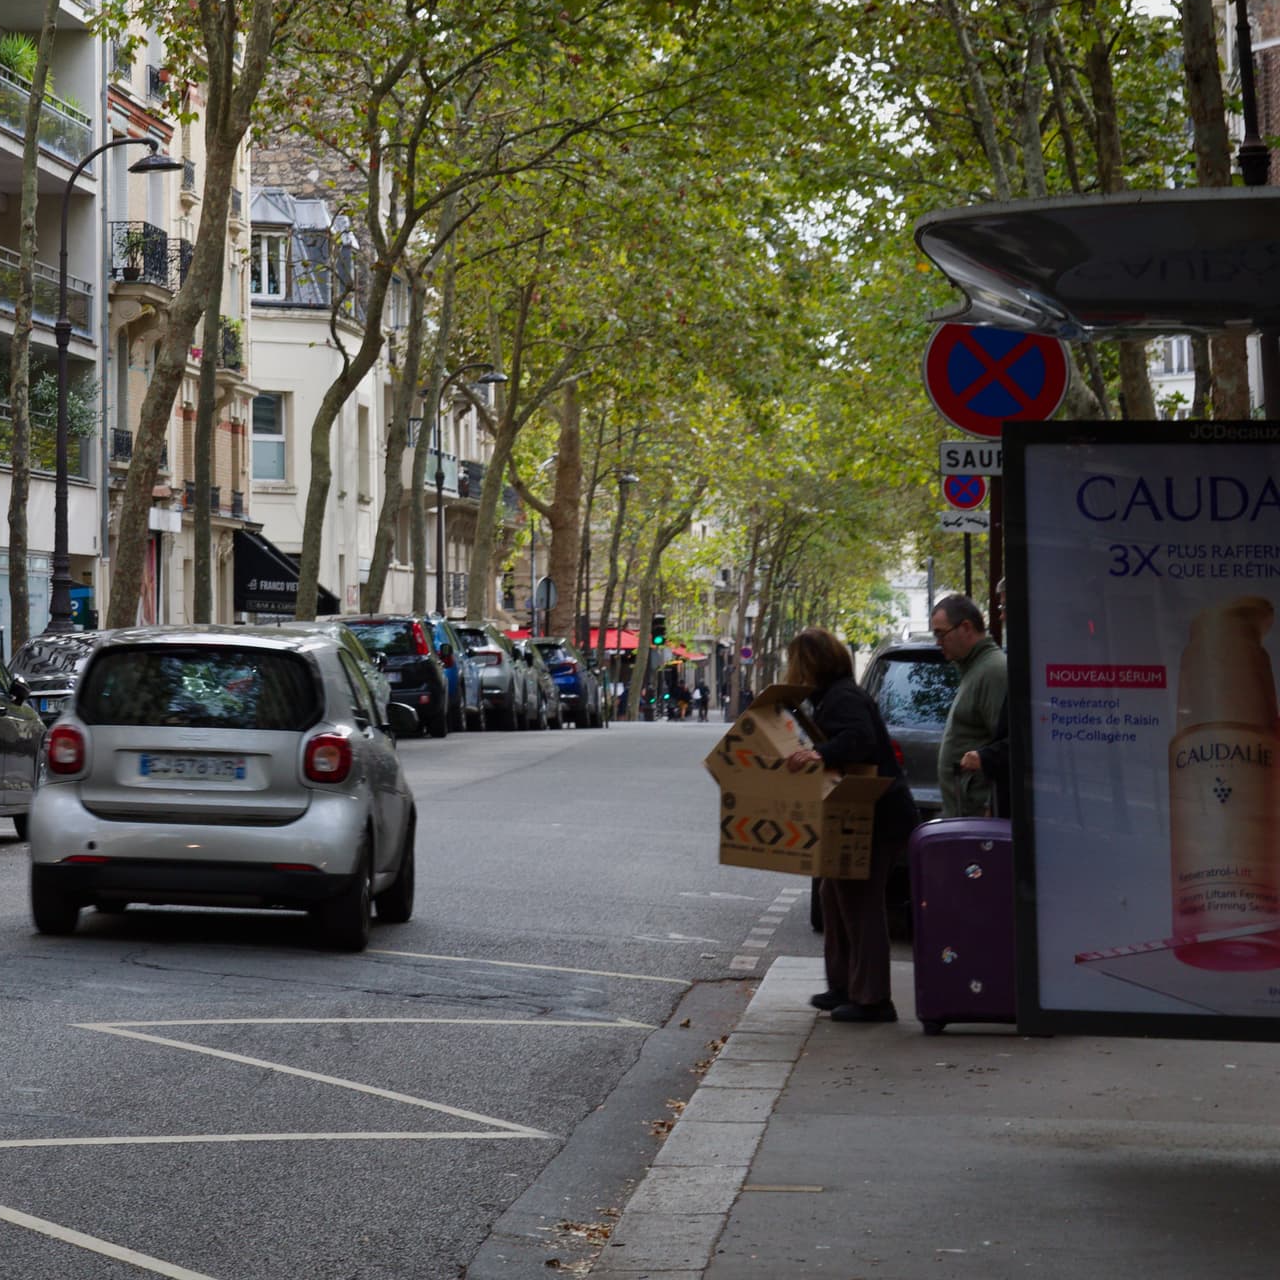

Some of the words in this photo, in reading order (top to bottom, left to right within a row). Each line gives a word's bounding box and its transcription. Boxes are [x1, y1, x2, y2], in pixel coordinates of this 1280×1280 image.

[1189, 424, 1280, 441] JCDecaux
[1109, 544, 1164, 577] 3X
[1167, 544, 1207, 560] PLUS
[1167, 563, 1208, 580] QUE
[1210, 563, 1229, 578] LE
[259, 580, 286, 592] FRANCO
[1049, 670, 1115, 683] NOUVEAU
[1119, 668, 1162, 683] SÉRUM
[1050, 696, 1120, 709] Resvératrol
[1051, 712, 1102, 727] Peptides
[1105, 713, 1120, 726] de
[1124, 713, 1160, 726] Raisin
[1051, 729, 1137, 744] Pro-Collagène
[1207, 901, 1247, 913] Firming
